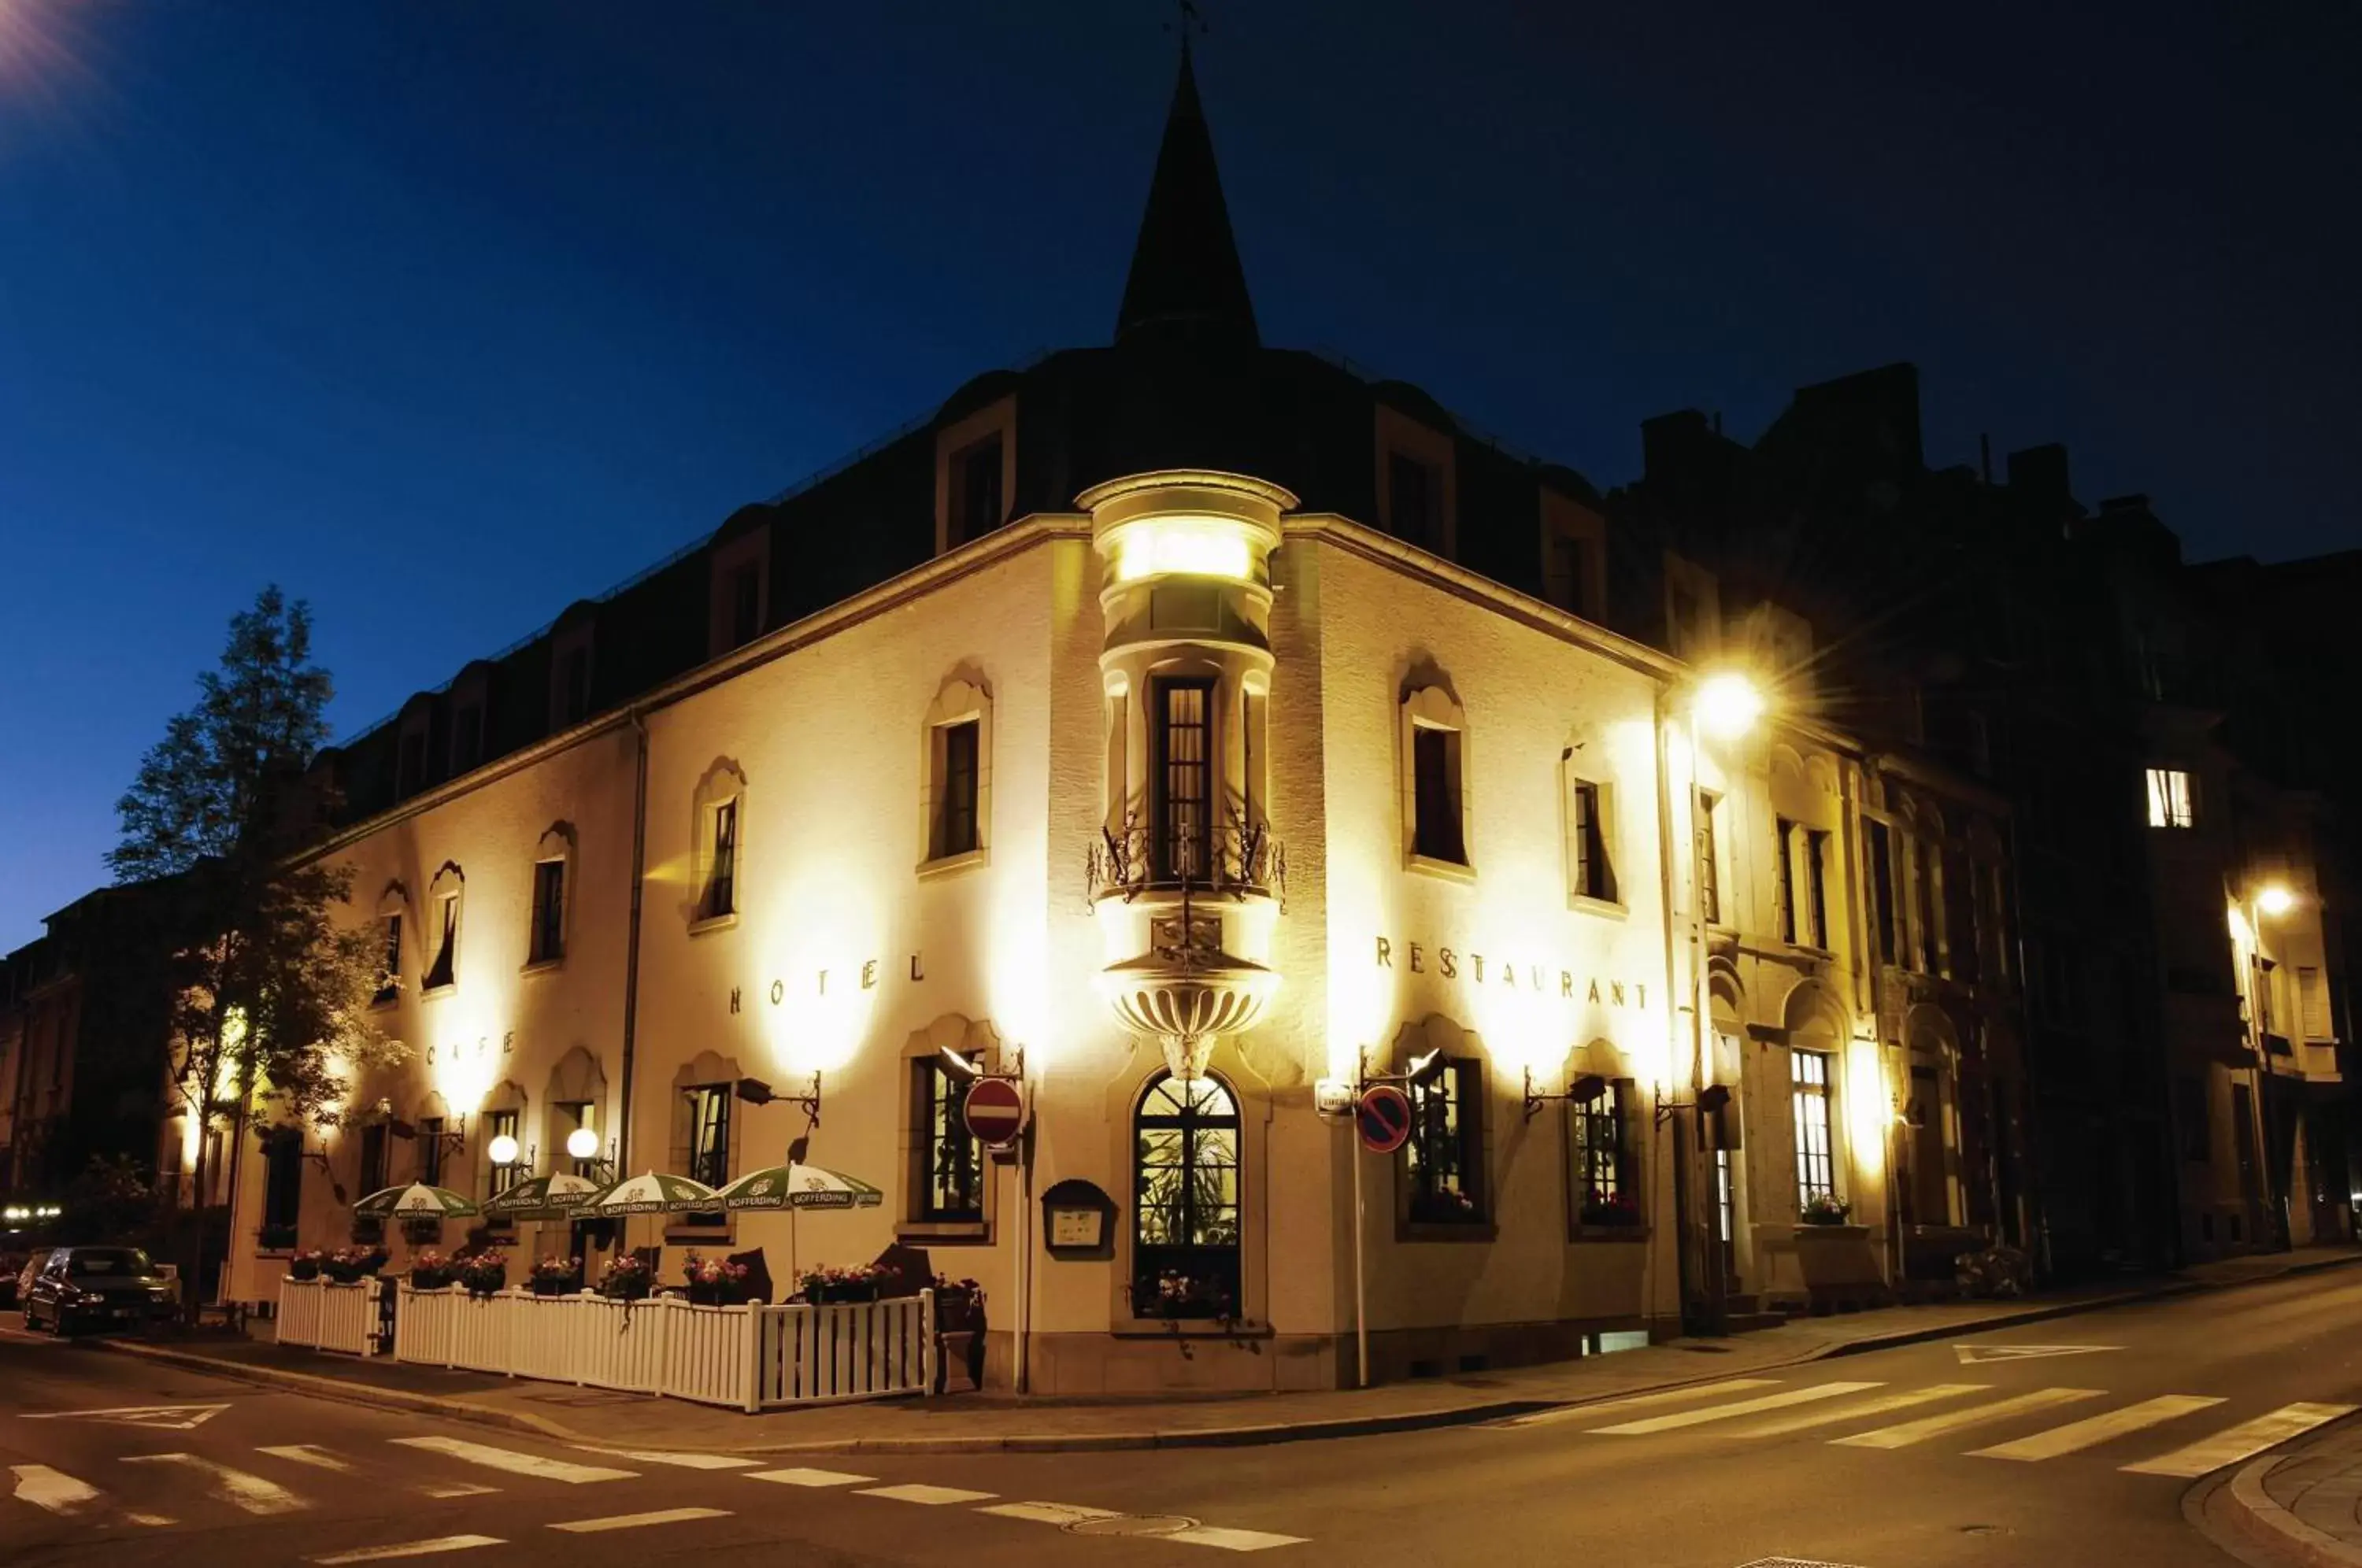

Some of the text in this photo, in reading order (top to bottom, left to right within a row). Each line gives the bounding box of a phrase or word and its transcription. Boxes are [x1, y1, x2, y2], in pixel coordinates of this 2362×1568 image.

[730, 954, 924, 1015] HOTEL
[1376, 937, 1646, 1008] RESTAURANT
[605, 1204, 657, 1215] BOFFERDING
[728, 1196, 782, 1207] BOFFERDING
